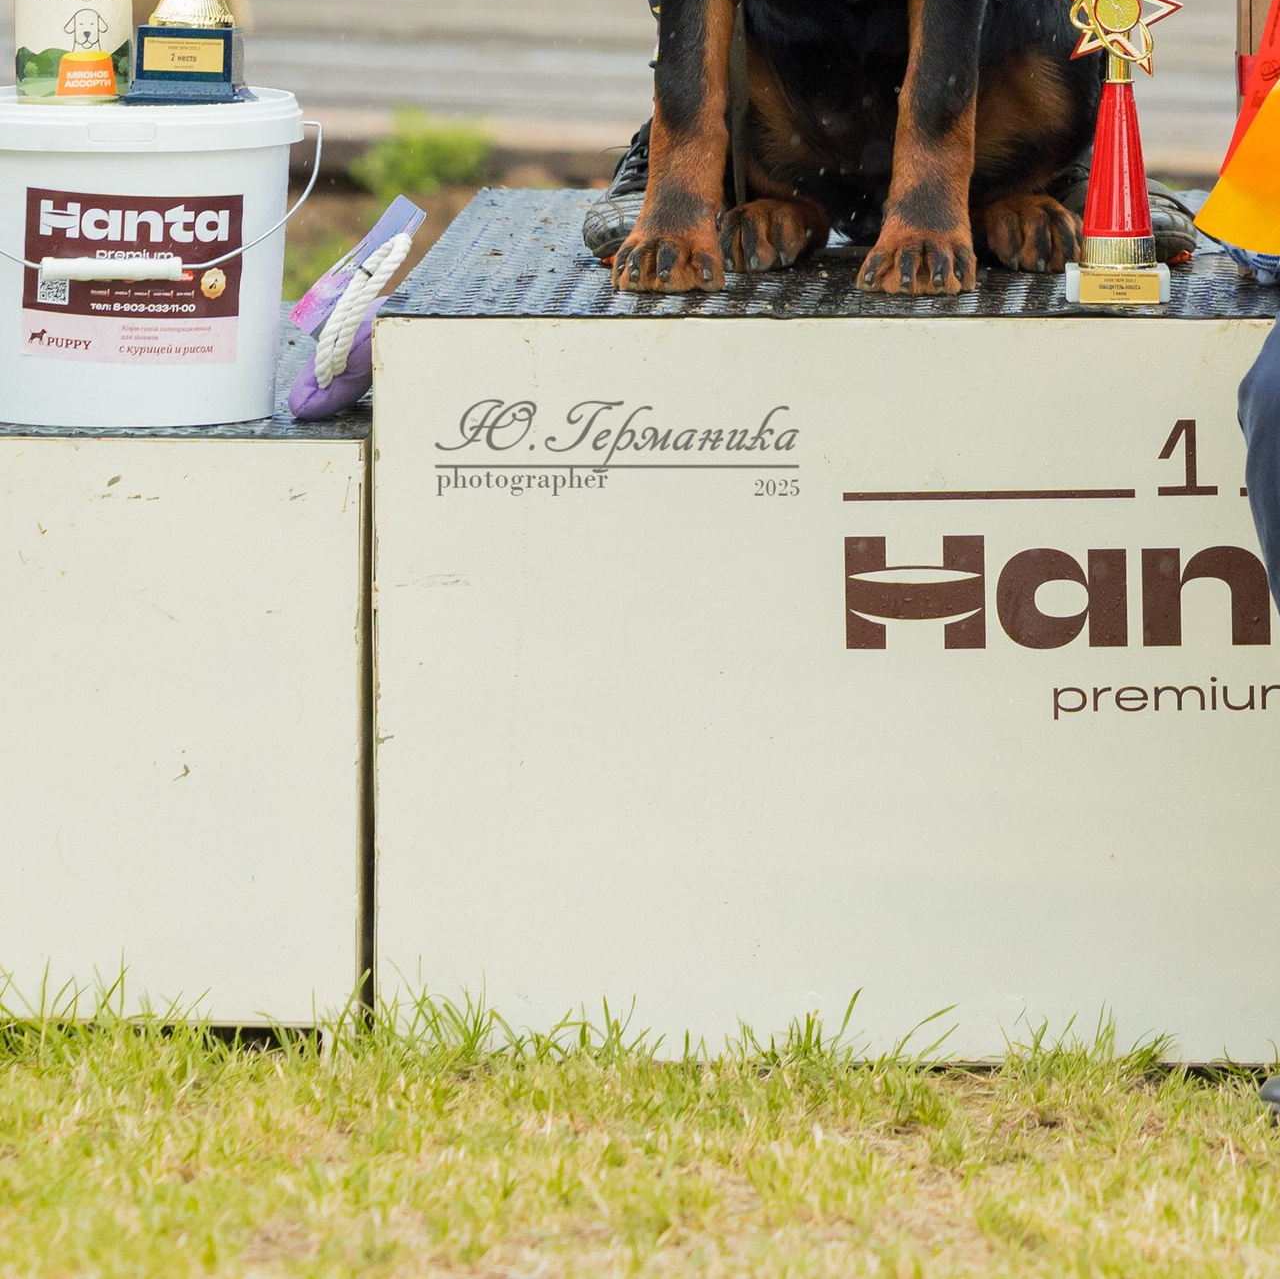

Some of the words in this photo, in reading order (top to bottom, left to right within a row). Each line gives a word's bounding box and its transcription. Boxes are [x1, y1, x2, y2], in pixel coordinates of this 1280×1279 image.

[66, 70, 110, 79] МЯСНОЕ
[64, 79, 112, 88] АССОРТИ
[39, 199, 230, 243] Hanta
[90, 302, 112, 311] тел:
[112, 302, 196, 313] 8-903-033-11-00
[47, 336, 92, 350] PUPPY
[119, 345, 125, 353] с
[126, 344, 173, 356] курицей
[175, 345, 181, 353] и
[182, 344, 213, 356] рисом
[1157, 419, 1219, 496] 1
